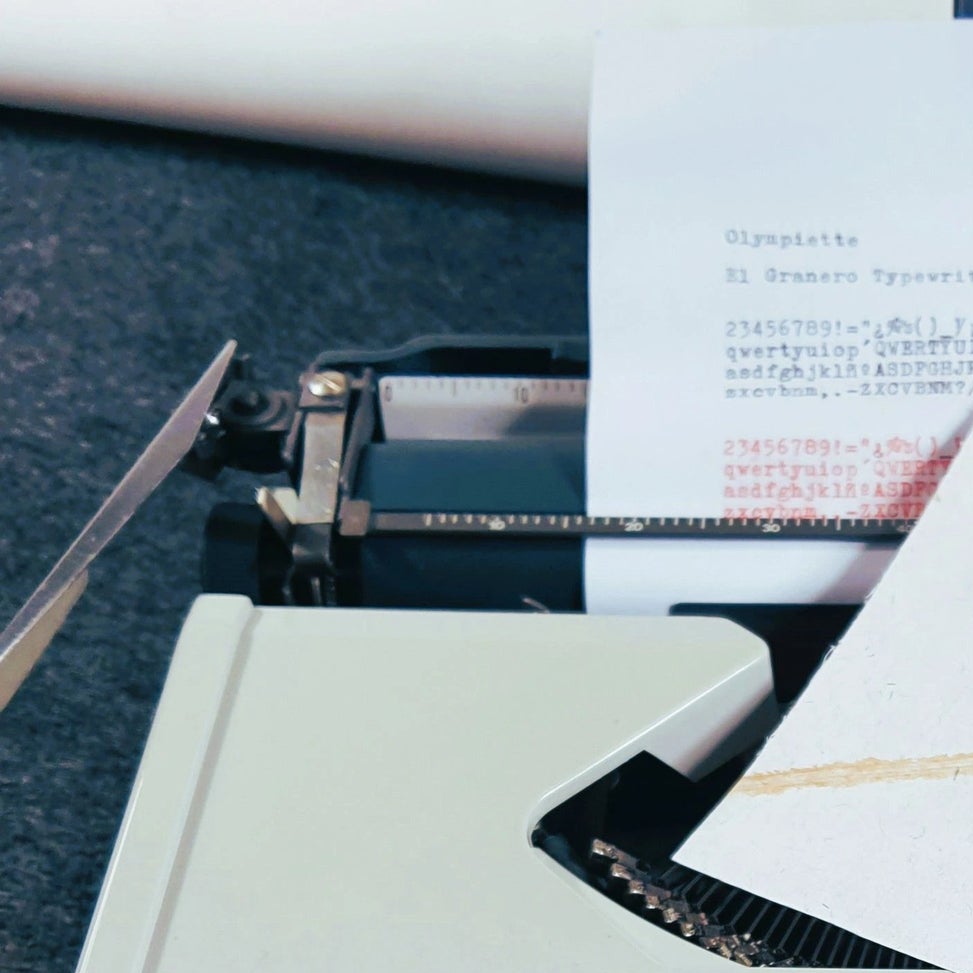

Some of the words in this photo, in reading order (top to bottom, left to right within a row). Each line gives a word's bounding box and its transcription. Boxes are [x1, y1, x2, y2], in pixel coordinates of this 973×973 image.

[725, 229, 858, 248] Olympiette
[725, 268, 750, 284] El
[764, 267, 858, 285] Granero
[625, 521, 644, 532] 20
[761, 523, 781, 533] 30
